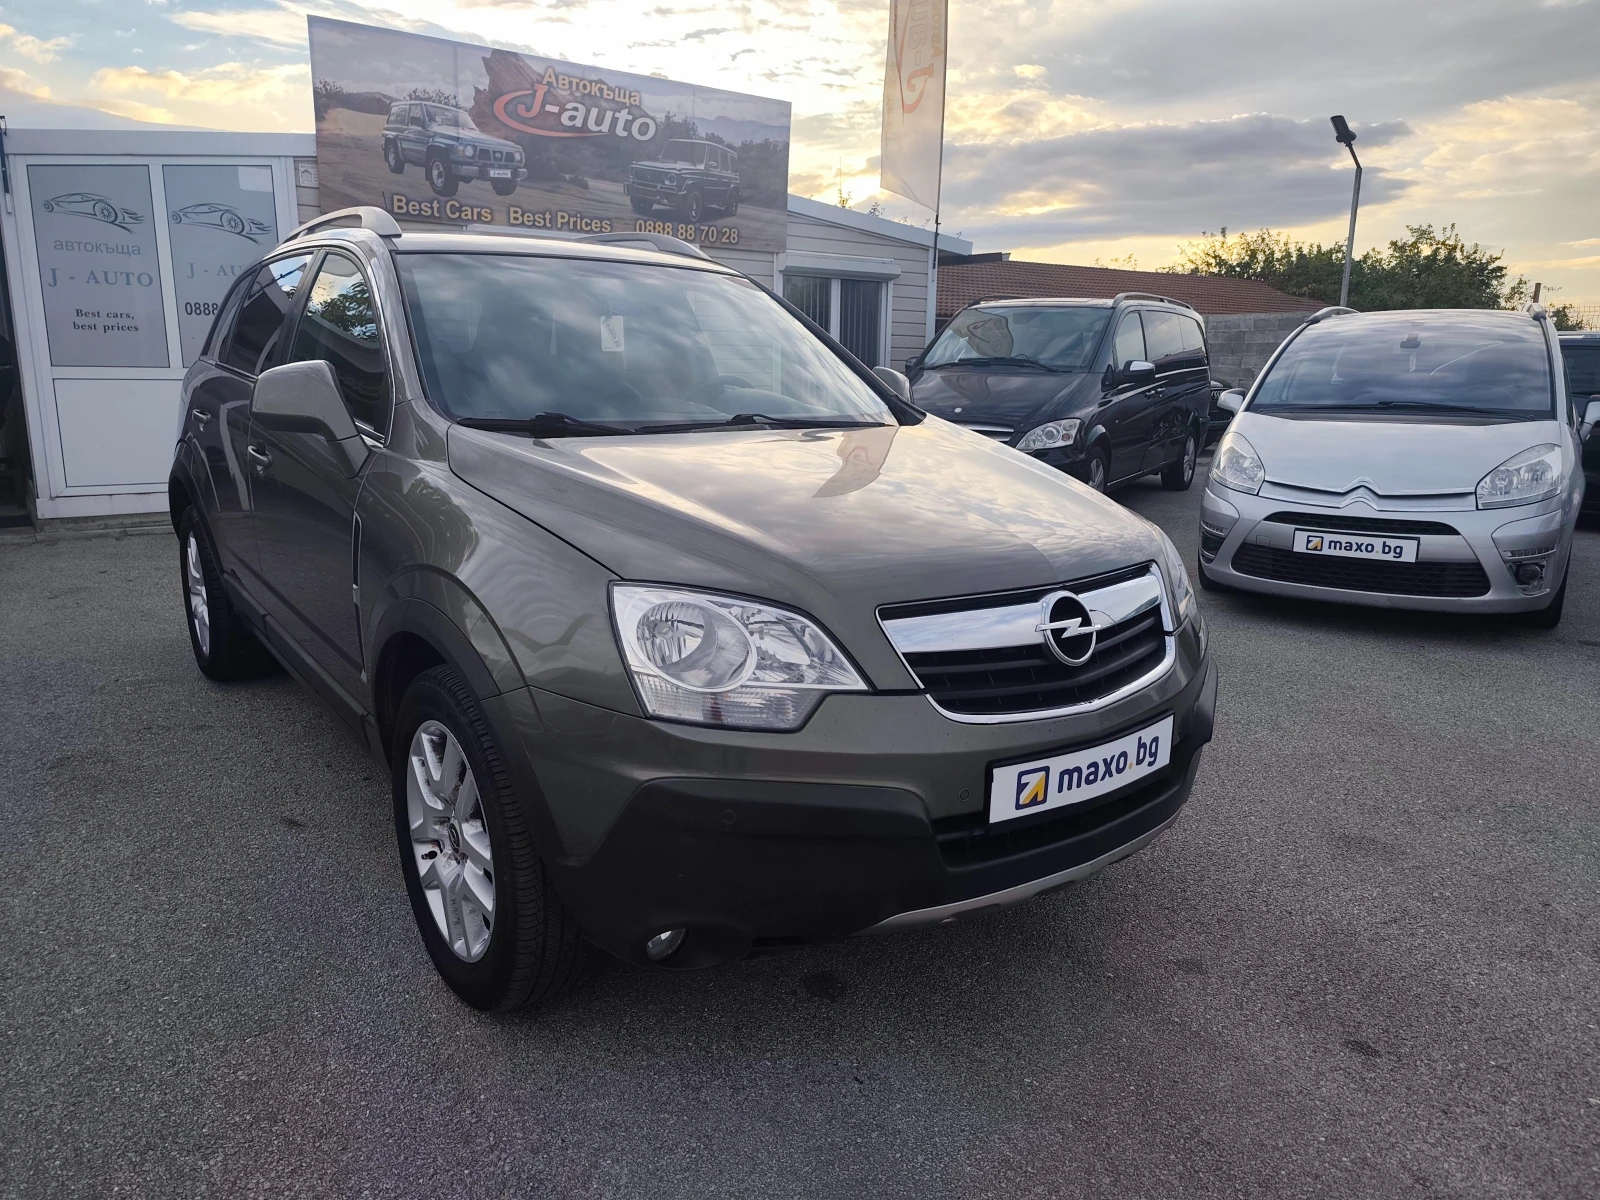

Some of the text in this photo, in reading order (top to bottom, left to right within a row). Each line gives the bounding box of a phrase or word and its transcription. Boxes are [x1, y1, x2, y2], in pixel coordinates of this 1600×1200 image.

[542, 67, 641, 106] Автокъща
[517, 84, 657, 141] J-auto
[393, 195, 611, 233] Best Cars Best Prices
[636, 219, 738, 243] 0888 88 70 28
[53, 239, 141, 257] автокъща
[48, 268, 58, 287] J
[85, 269, 153, 287] AUTO
[187, 263, 195, 279] J
[75, 308, 135, 320] Best cars,
[184, 302, 219, 316] 0888
[73, 321, 139, 333] best prices
[1327, 539, 1404, 559] maxo.bg
[1057, 736, 1160, 794] maxo.bg
